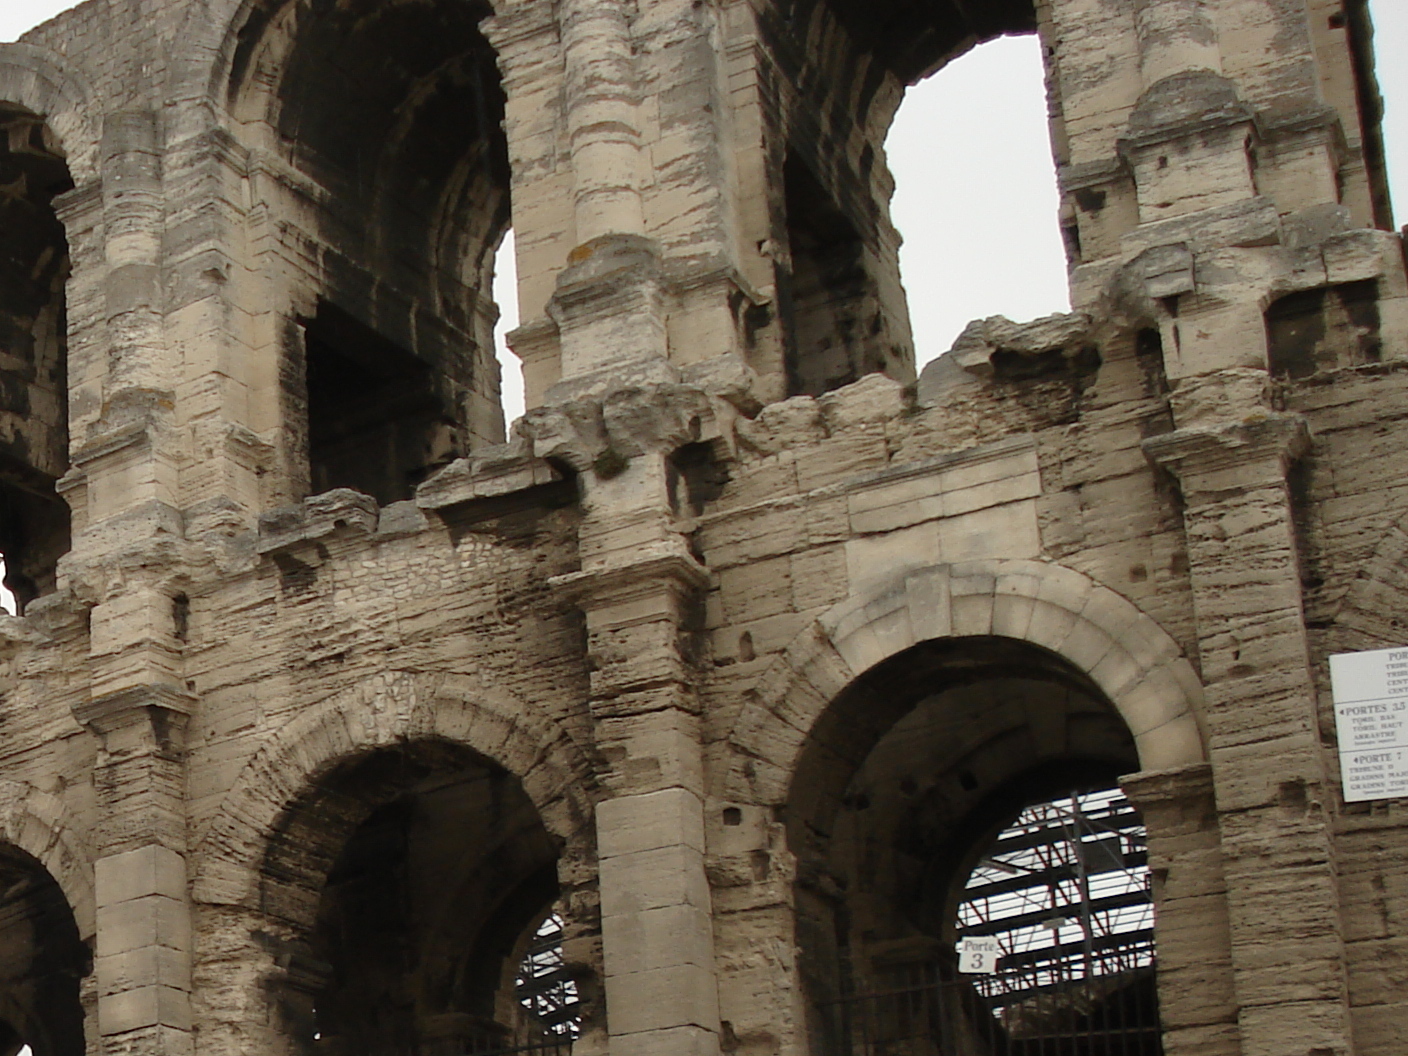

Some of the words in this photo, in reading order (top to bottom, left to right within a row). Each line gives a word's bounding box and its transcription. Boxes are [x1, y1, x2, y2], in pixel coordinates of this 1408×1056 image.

[1346, 704, 1387, 716] PORTES
[1359, 753, 1392, 764] PORTE
[964, 941, 995, 952] Porte
[971, 953, 983, 969] 3
